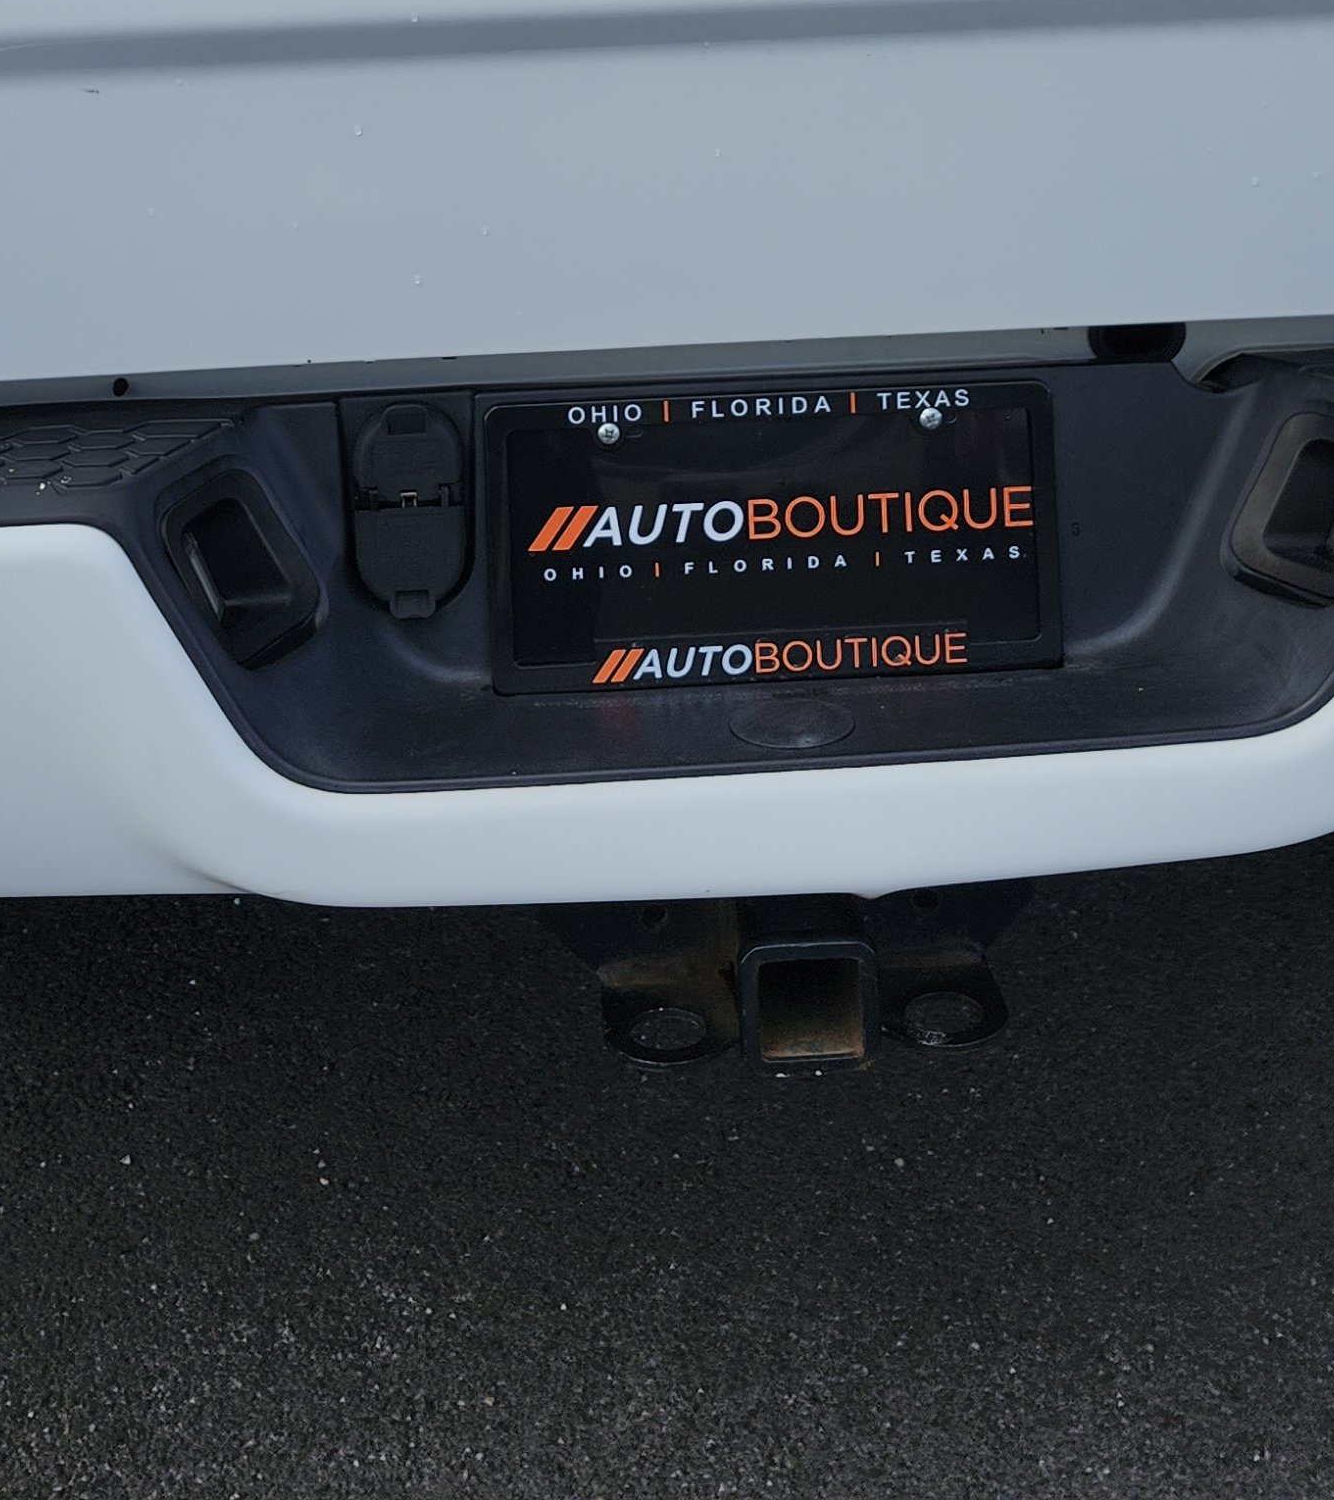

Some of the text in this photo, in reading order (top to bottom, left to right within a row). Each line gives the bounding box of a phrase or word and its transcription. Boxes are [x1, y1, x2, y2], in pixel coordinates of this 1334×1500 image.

[567, 388, 970, 425] OHIO FLORIDA TEXAS
[582, 485, 1034, 548] AUTOBOUTIQUE
[543, 545, 1021, 582] OHIO FLORIDA TEXAS
[632, 632, 968, 681] AUTOBOUTIQUE
